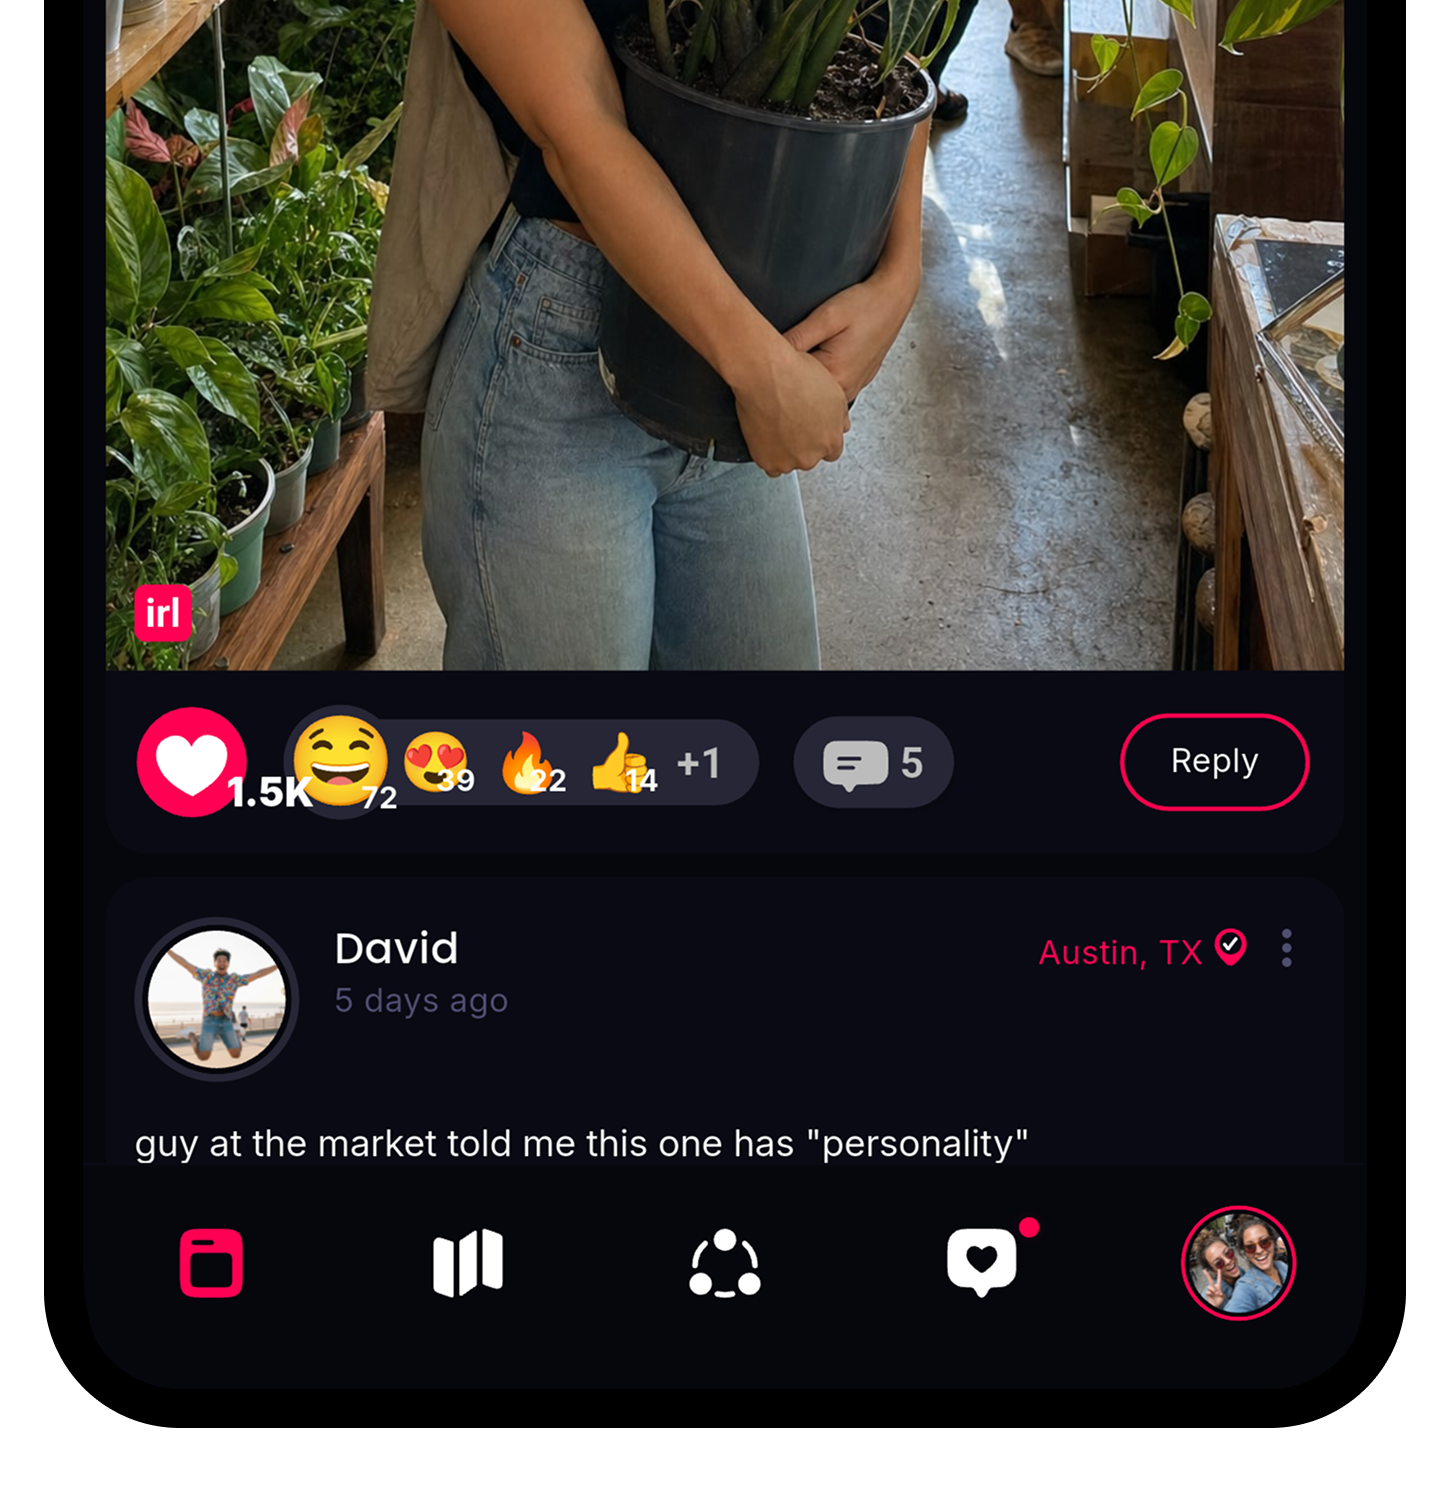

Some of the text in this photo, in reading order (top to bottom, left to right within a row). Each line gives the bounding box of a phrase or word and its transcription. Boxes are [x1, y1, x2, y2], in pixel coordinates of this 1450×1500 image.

[148, 597, 178, 627] irl
[678, 747, 717, 778] +1
[902, 747, 922, 778] 5
[1173, 748, 1258, 779] Reply
[227, 777, 313, 806] 1.5K
[437, 769, 474, 791] 39
[530, 769, 566, 791] 22
[626, 769, 657, 791] 14
[362, 786, 396, 808] 72
[337, 930, 456, 963] David
[1039, 939, 1202, 970] Austin, TX
[336, 988, 507, 1019] 5 days ago
[136, 1129, 1027, 1163] guy at the market told me this one has "personality"
